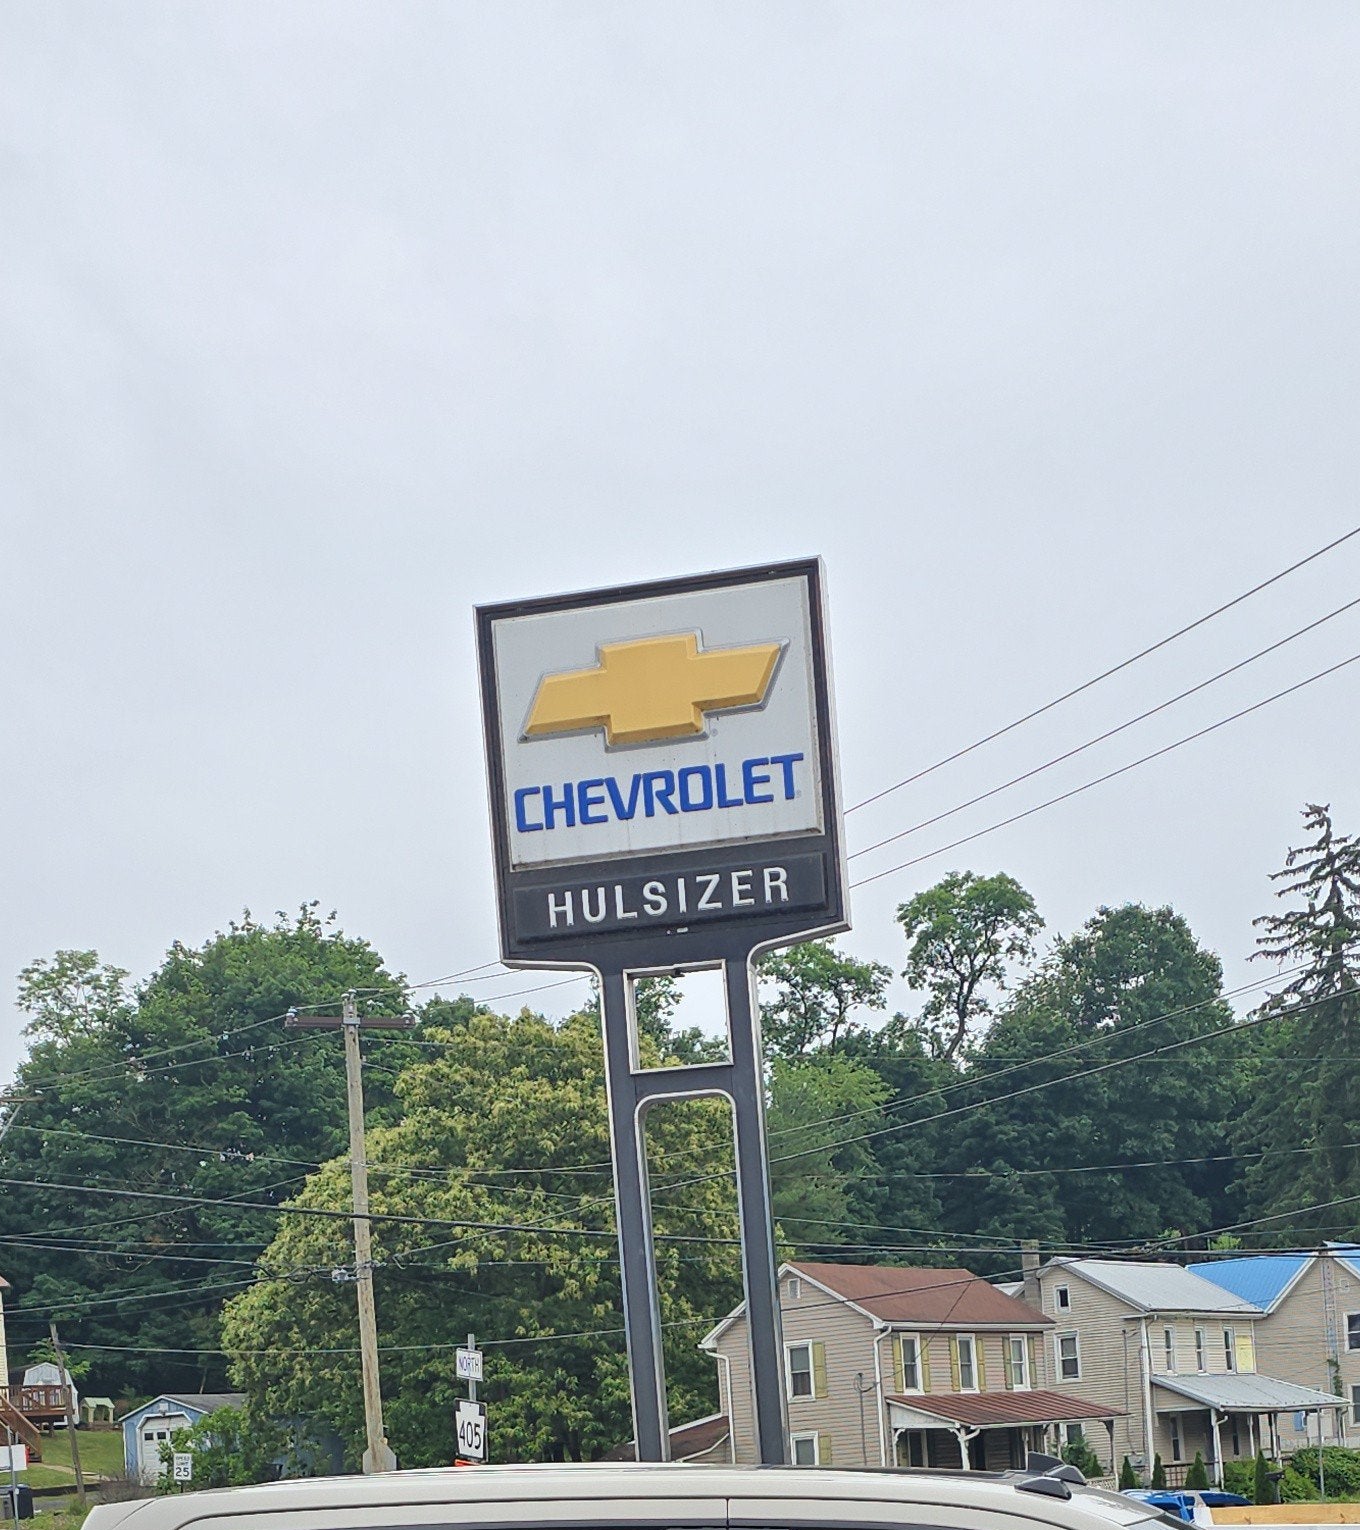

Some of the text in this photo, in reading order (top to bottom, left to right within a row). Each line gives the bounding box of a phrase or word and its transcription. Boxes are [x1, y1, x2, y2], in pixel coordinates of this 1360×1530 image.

[514, 752, 804, 833] CHEVROLET
[547, 866, 789, 928] HULSIZER
[460, 1356, 479, 1373] NORTH
[459, 1420, 482, 1450] 405
[175, 1466, 190, 1478] 25
